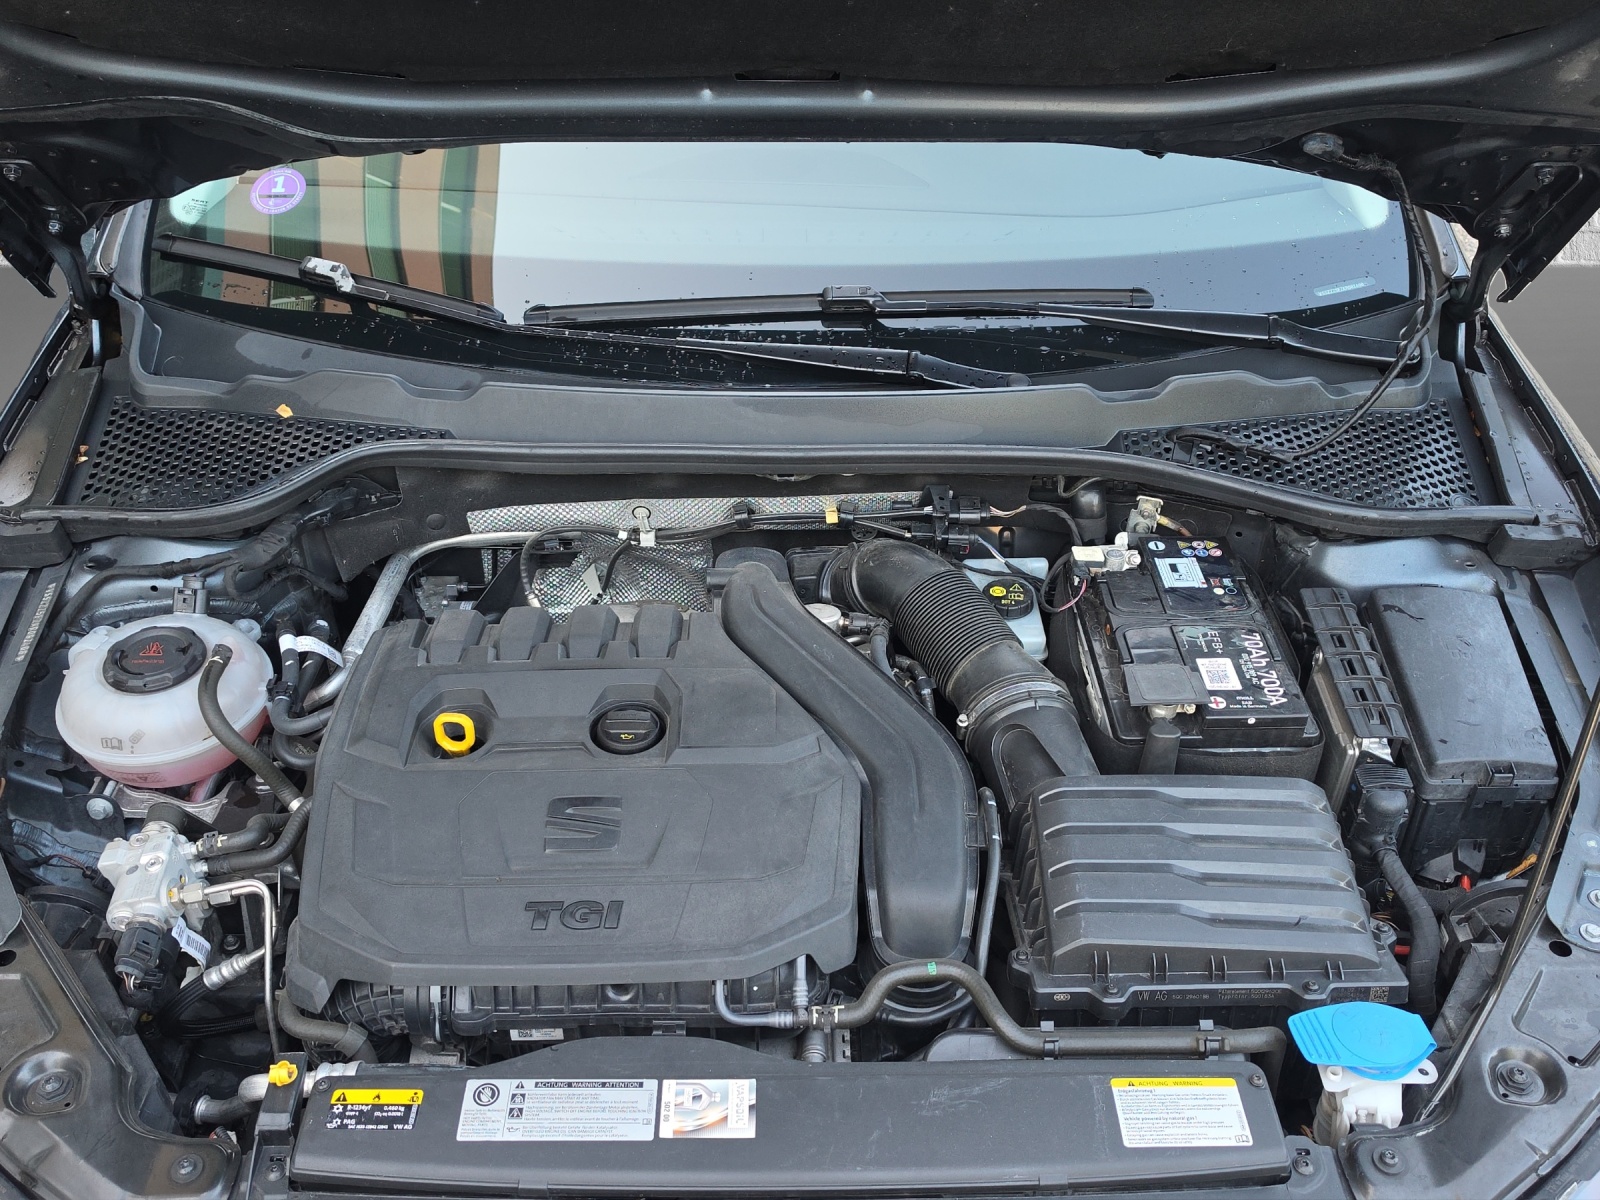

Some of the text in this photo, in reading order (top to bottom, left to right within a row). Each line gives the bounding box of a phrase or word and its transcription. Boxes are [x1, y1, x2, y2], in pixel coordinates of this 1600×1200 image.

[271, 175, 286, 193] 1
[1208, 630, 1224, 654] EFB+
[1241, 632, 1288, 706] 70Ah 700A
[524, 900, 624, 930] TGI
[1137, 991, 1150, 1000] VW
[1154, 990, 1168, 1000] AG
[663, 1114, 670, 1122] 00
